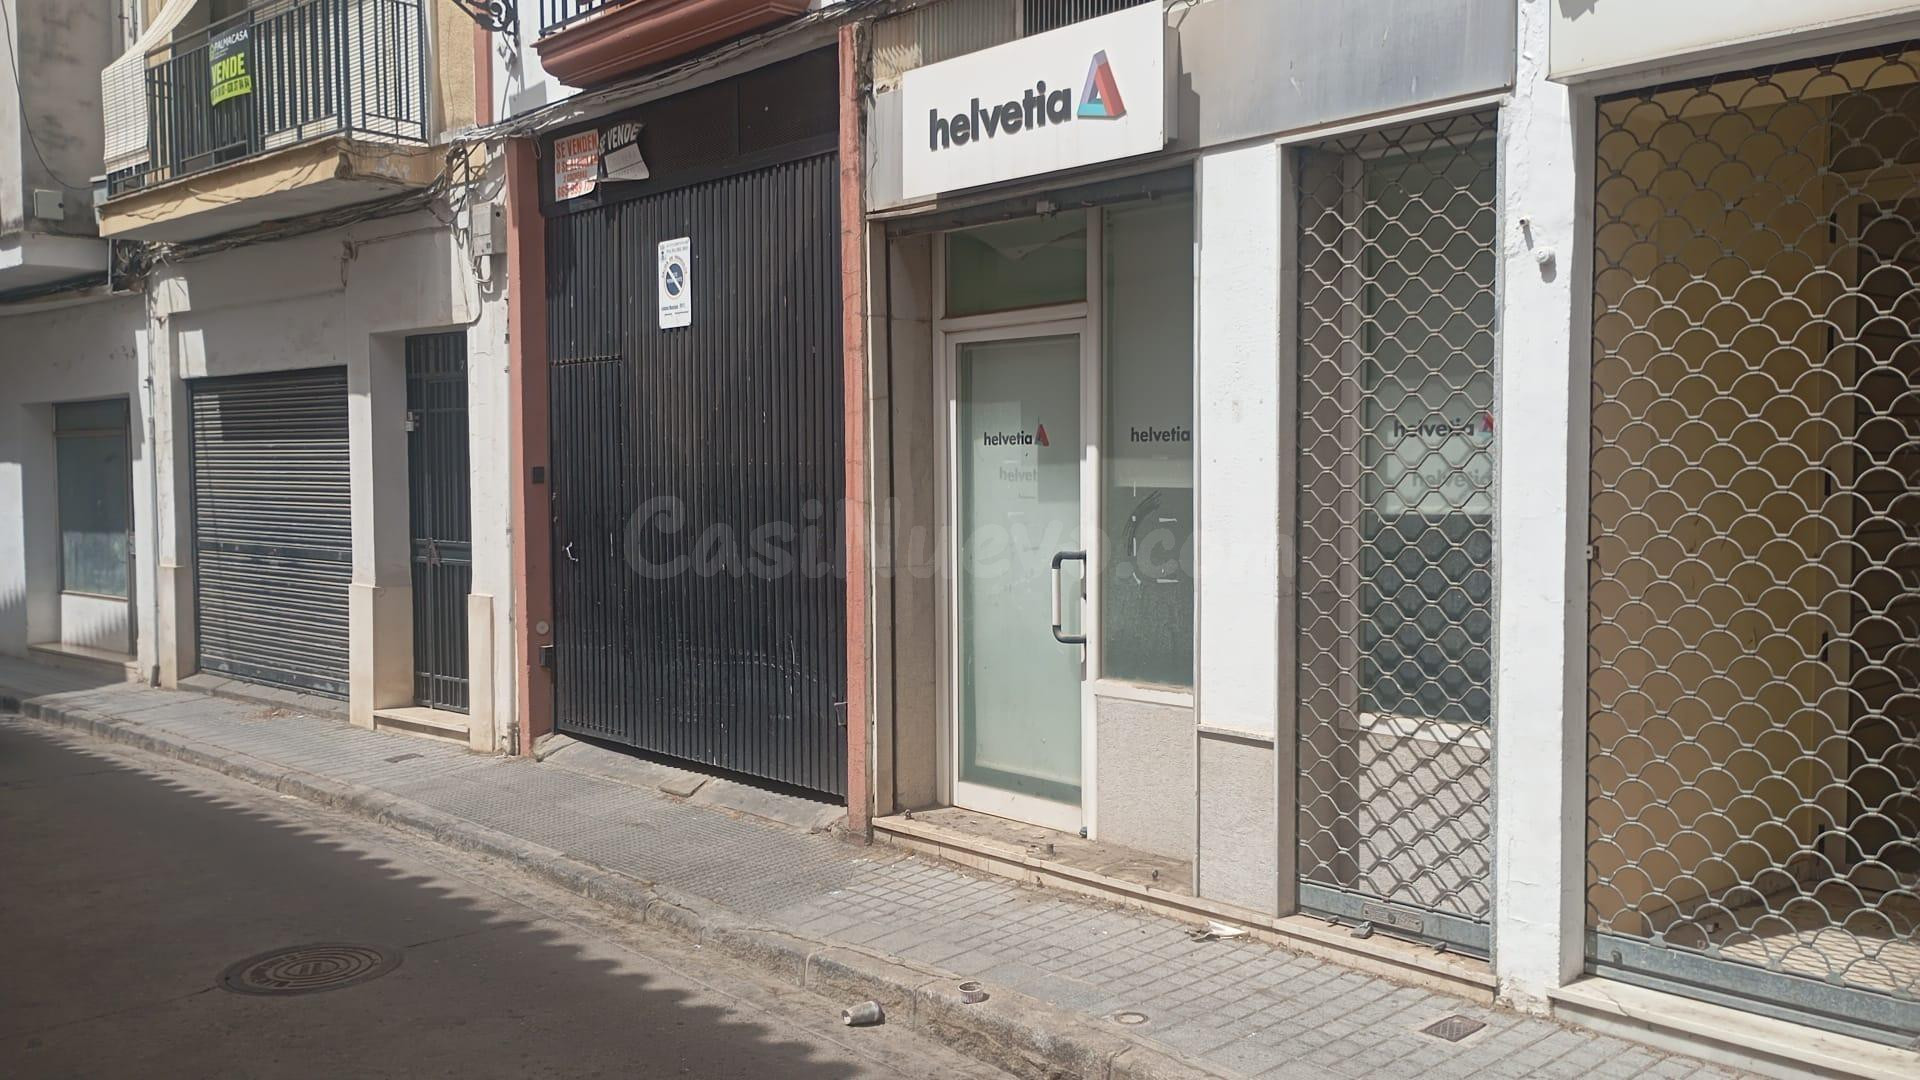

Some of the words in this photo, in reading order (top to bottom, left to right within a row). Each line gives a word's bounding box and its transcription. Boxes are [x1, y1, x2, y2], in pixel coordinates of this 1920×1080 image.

[211, 52, 245, 86] VENDE
[929, 80, 1072, 152] helvetia
[556, 142, 566, 160] SE
[567, 132, 597, 156] VENDEN
[607, 123, 640, 150] VENDE
[984, 431, 1033, 446] helvetia
[1131, 426, 1191, 442] helvetia
[1394, 415, 1475, 438] hlveia
